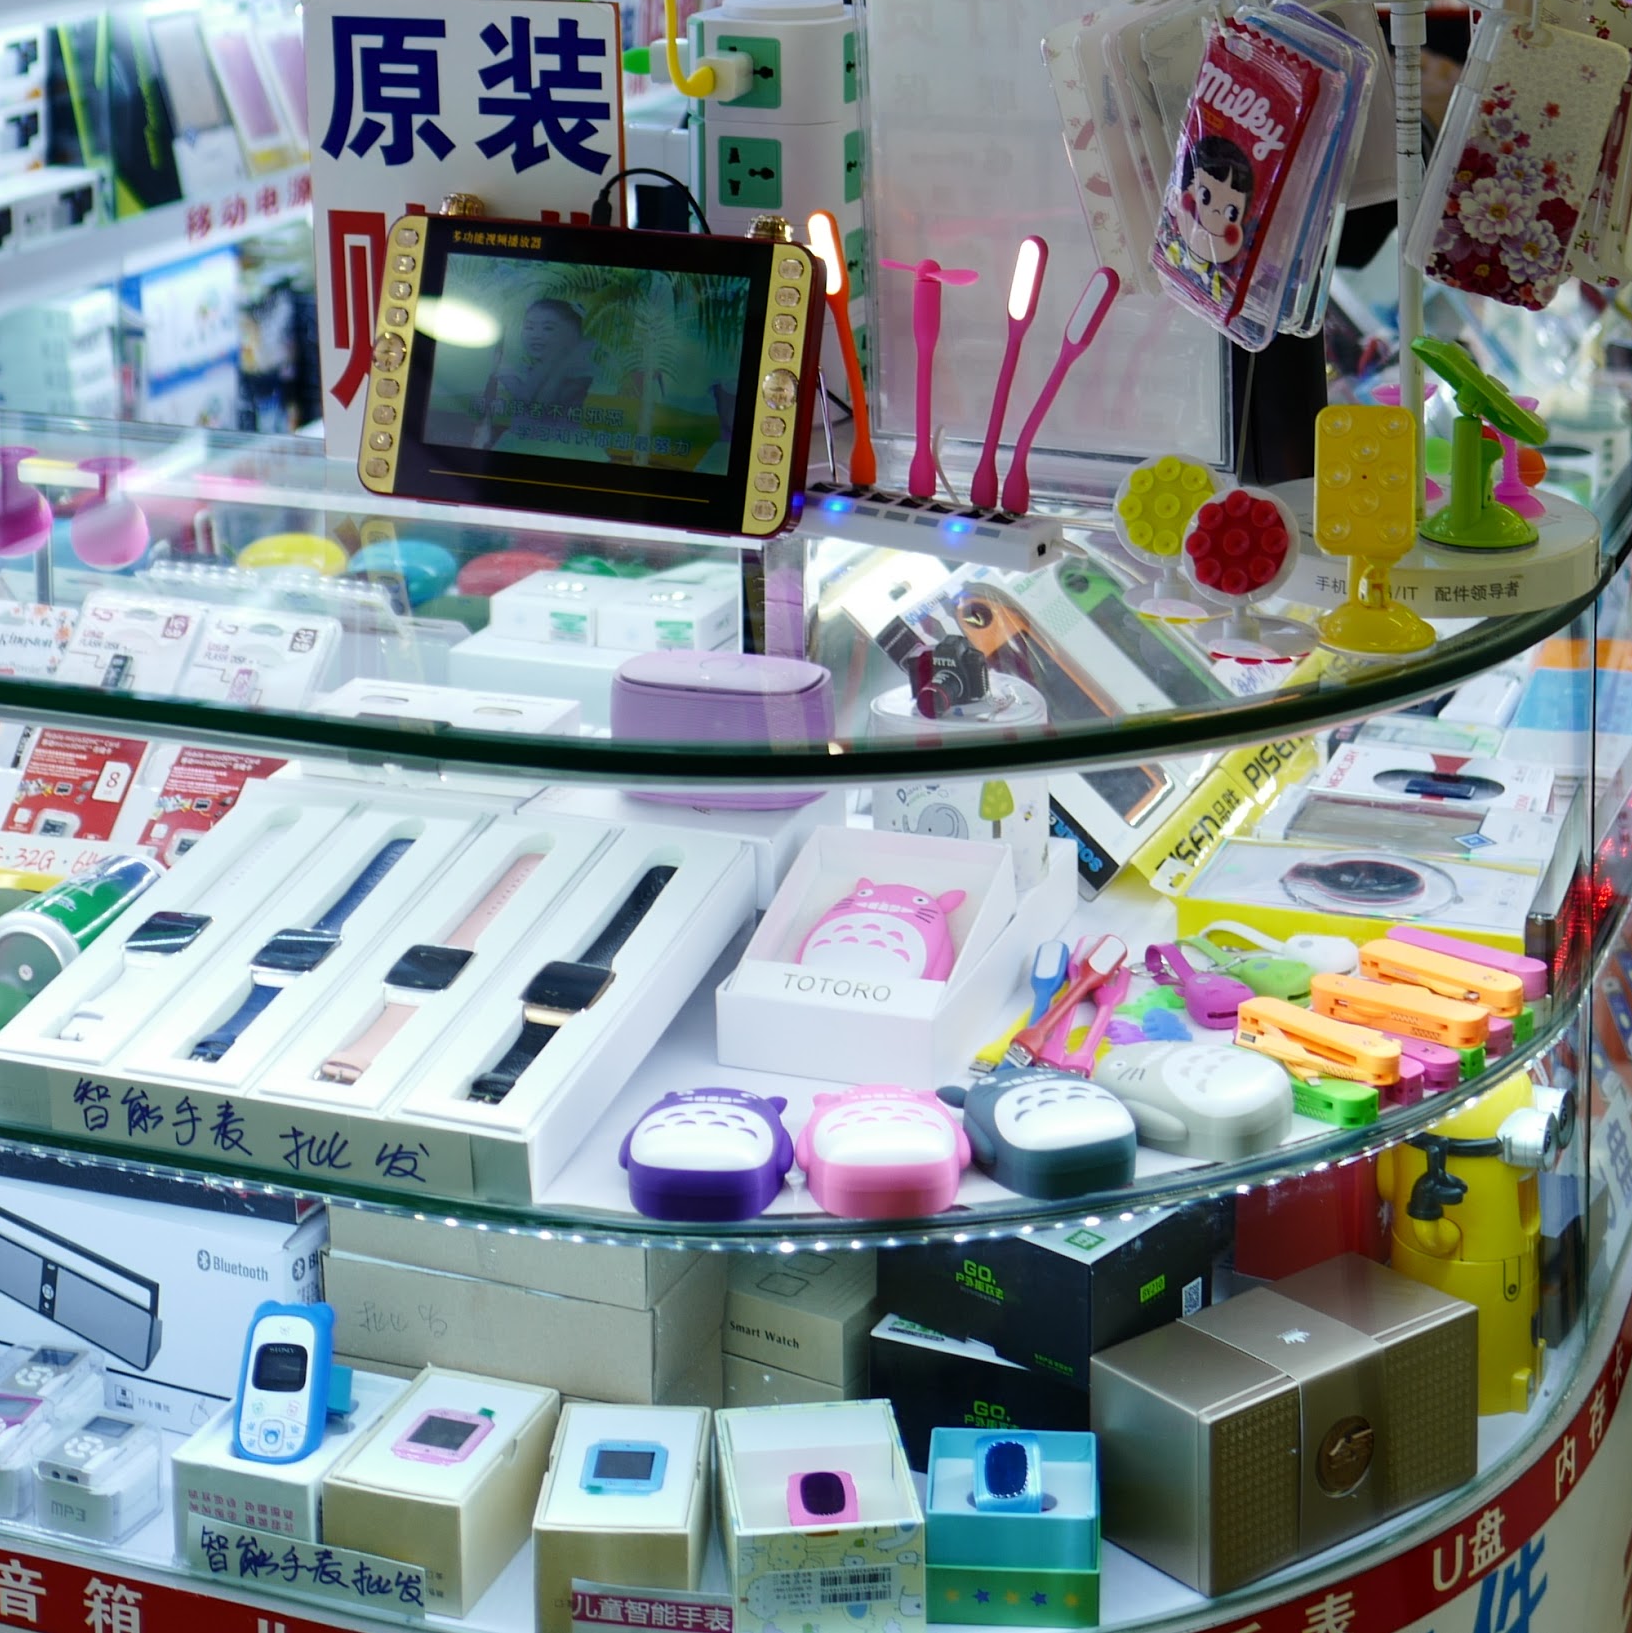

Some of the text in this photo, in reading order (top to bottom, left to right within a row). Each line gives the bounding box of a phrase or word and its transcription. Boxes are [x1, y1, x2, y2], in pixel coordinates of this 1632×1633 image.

[320, 14, 613, 176] 原装
[1197, 60, 1287, 158] Milky
[452, 228, 543, 251] 多功能视频播放器
[1433, 578, 1521, 605] 配件领导者
[106, 770, 120, 789] 8
[1156, 814, 1219, 872] ISEN
[783, 971, 892, 1005] TOTORO
[72, 1076, 430, 1184] 智能手表 批发
[212, 1254, 269, 1283] Bluetooth
[729, 1317, 801, 1350] Smart Watch
[200, 1524, 427, 1608] 智能手表批发
[1431, 1504, 1507, 1595] U盘
[572, 1593, 734, 1633] 儿童智能手表
